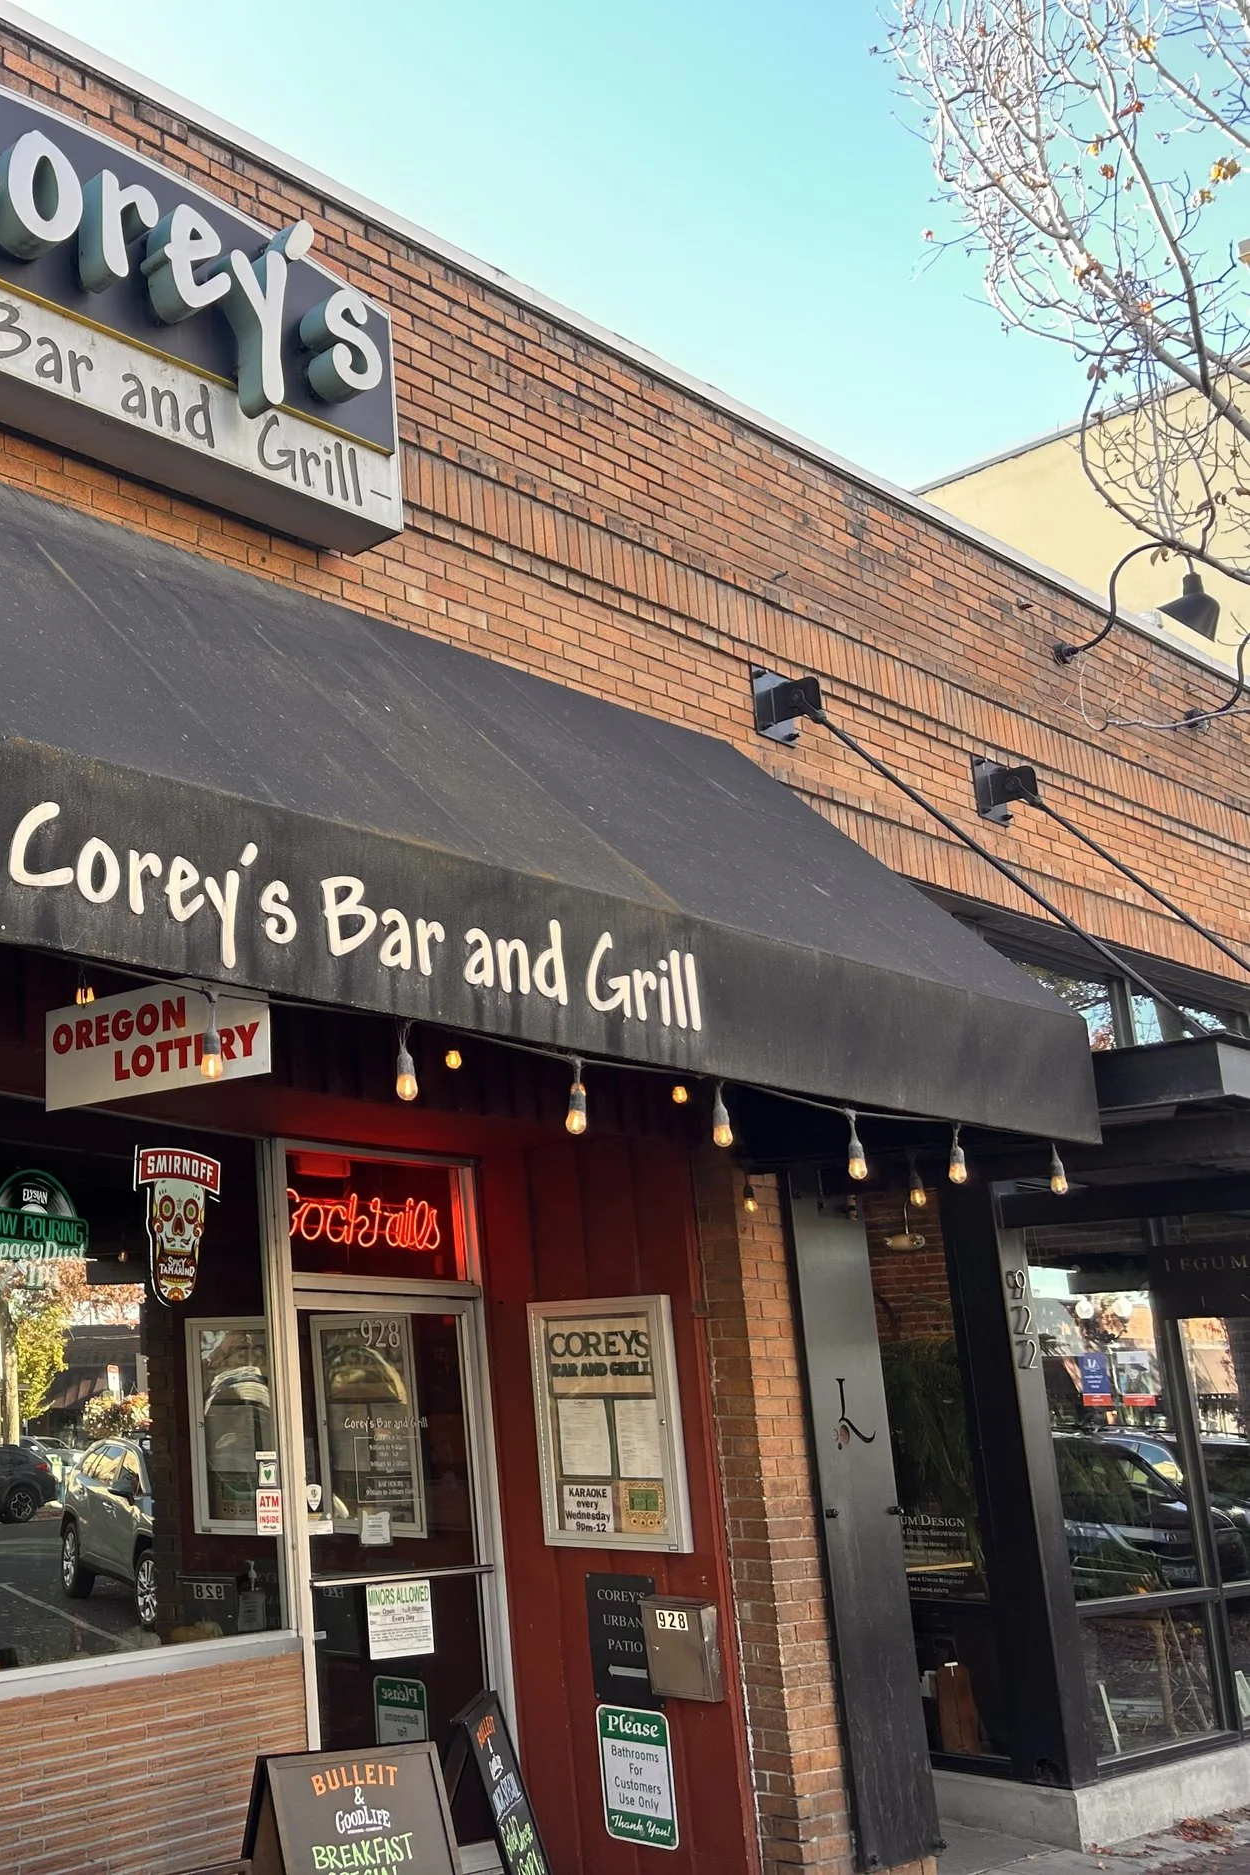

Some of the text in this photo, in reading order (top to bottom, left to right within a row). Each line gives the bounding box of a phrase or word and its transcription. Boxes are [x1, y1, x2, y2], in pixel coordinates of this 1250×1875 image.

[121, 371, 215, 449] and
[257, 415, 363, 506] Grill
[7, 802, 702, 1031] Corey's Bar and Grill
[52, 996, 186, 1055] OREGON
[146, 1154, 214, 1184] SMIRNOFF
[22, 1188, 48, 1205] ELYSIAN
[23, 1214, 84, 1244] POURING
[44, 1241, 86, 1261] Dust
[158, 1263, 196, 1277] TAMARIND
[167, 1256, 186, 1268] SPICY
[1012, 1269, 1039, 1369] 922
[360, 1319, 400, 1348] 928
[550, 1329, 650, 1358] COREYS
[551, 1361, 651, 1377] BAR AND GRILL
[344, 1416, 375, 1432] Corey's
[376, 1418, 392, 1429] Bar
[393, 1416, 409, 1429] and
[259, 1495, 279, 1508] ATM
[568, 1488, 608, 1498] KARAOKE
[576, 1501, 598, 1510] every
[565, 1510, 611, 1523] Wednesday
[920, 1514, 965, 1527] DESIGN
[576, 1521, 607, 1533] 9pm-12
[367, 1585, 430, 1606] MINORS ALLOWED
[597, 1589, 645, 1603] COREY'S
[391, 1614, 415, 1623] Every Day
[603, 1614, 643, 1629] URBAN
[658, 1611, 686, 1629] 928
[608, 1639, 643, 1653] PATIO
[606, 1714, 660, 1737] Please
[611, 1744, 659, 1763] Bathrooms
[629, 1763, 643, 1776] For
[310, 1764, 398, 1796] BULLEIT
[614, 1776, 662, 1795] Customers
[353, 1786, 365, 1805] &
[618, 1792, 659, 1813] Use Only
[335, 1805, 391, 1834] GOODLIFE
[611, 1815, 672, 1838] Thank You!
[311, 1832, 413, 1870] BREAKFAST
